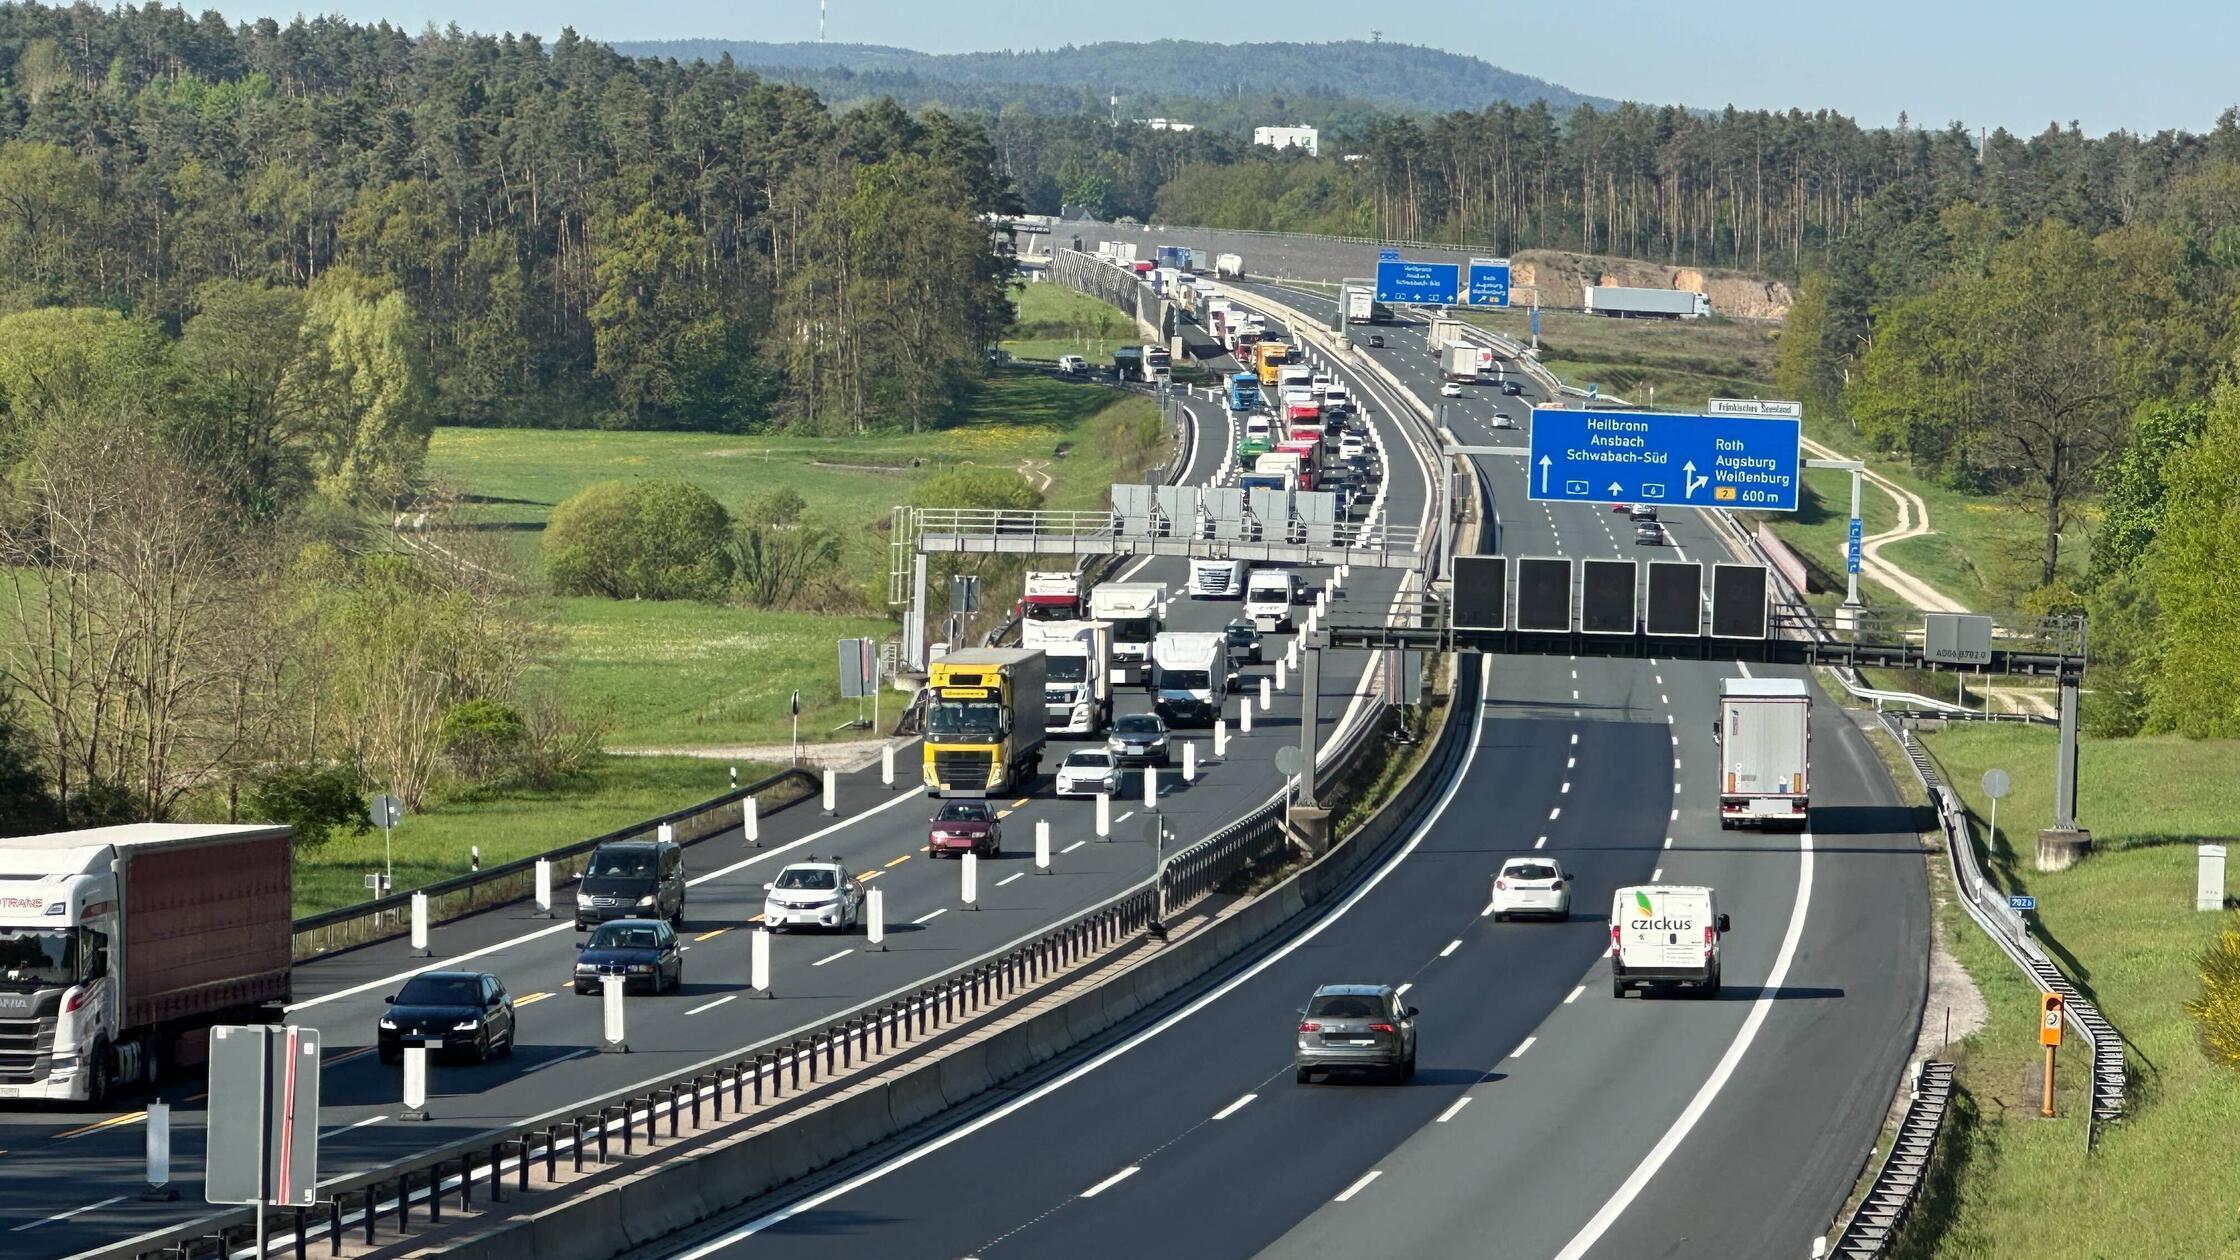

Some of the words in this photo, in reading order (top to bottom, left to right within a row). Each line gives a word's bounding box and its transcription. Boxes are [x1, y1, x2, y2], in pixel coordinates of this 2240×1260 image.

[1587, 418, 1648, 432] Heilbronn
[1590, 435, 1644, 447] Ansbach
[1715, 439, 1744, 451] Roth
[1566, 449, 1668, 464] Schwabach-Süd
[1715, 455, 1776, 470] Augsburg
[1715, 470, 1790, 487] Weißenburg
[1574, 483, 1581, 492] 6
[1650, 486, 1657, 495] 6
[1722, 489, 1729, 499] 2
[1742, 490, 1765, 502] 600
[1767, 494, 1779, 503] m
[0, 897, 43, 908] TRANS
[1631, 916, 1692, 930] czickus
